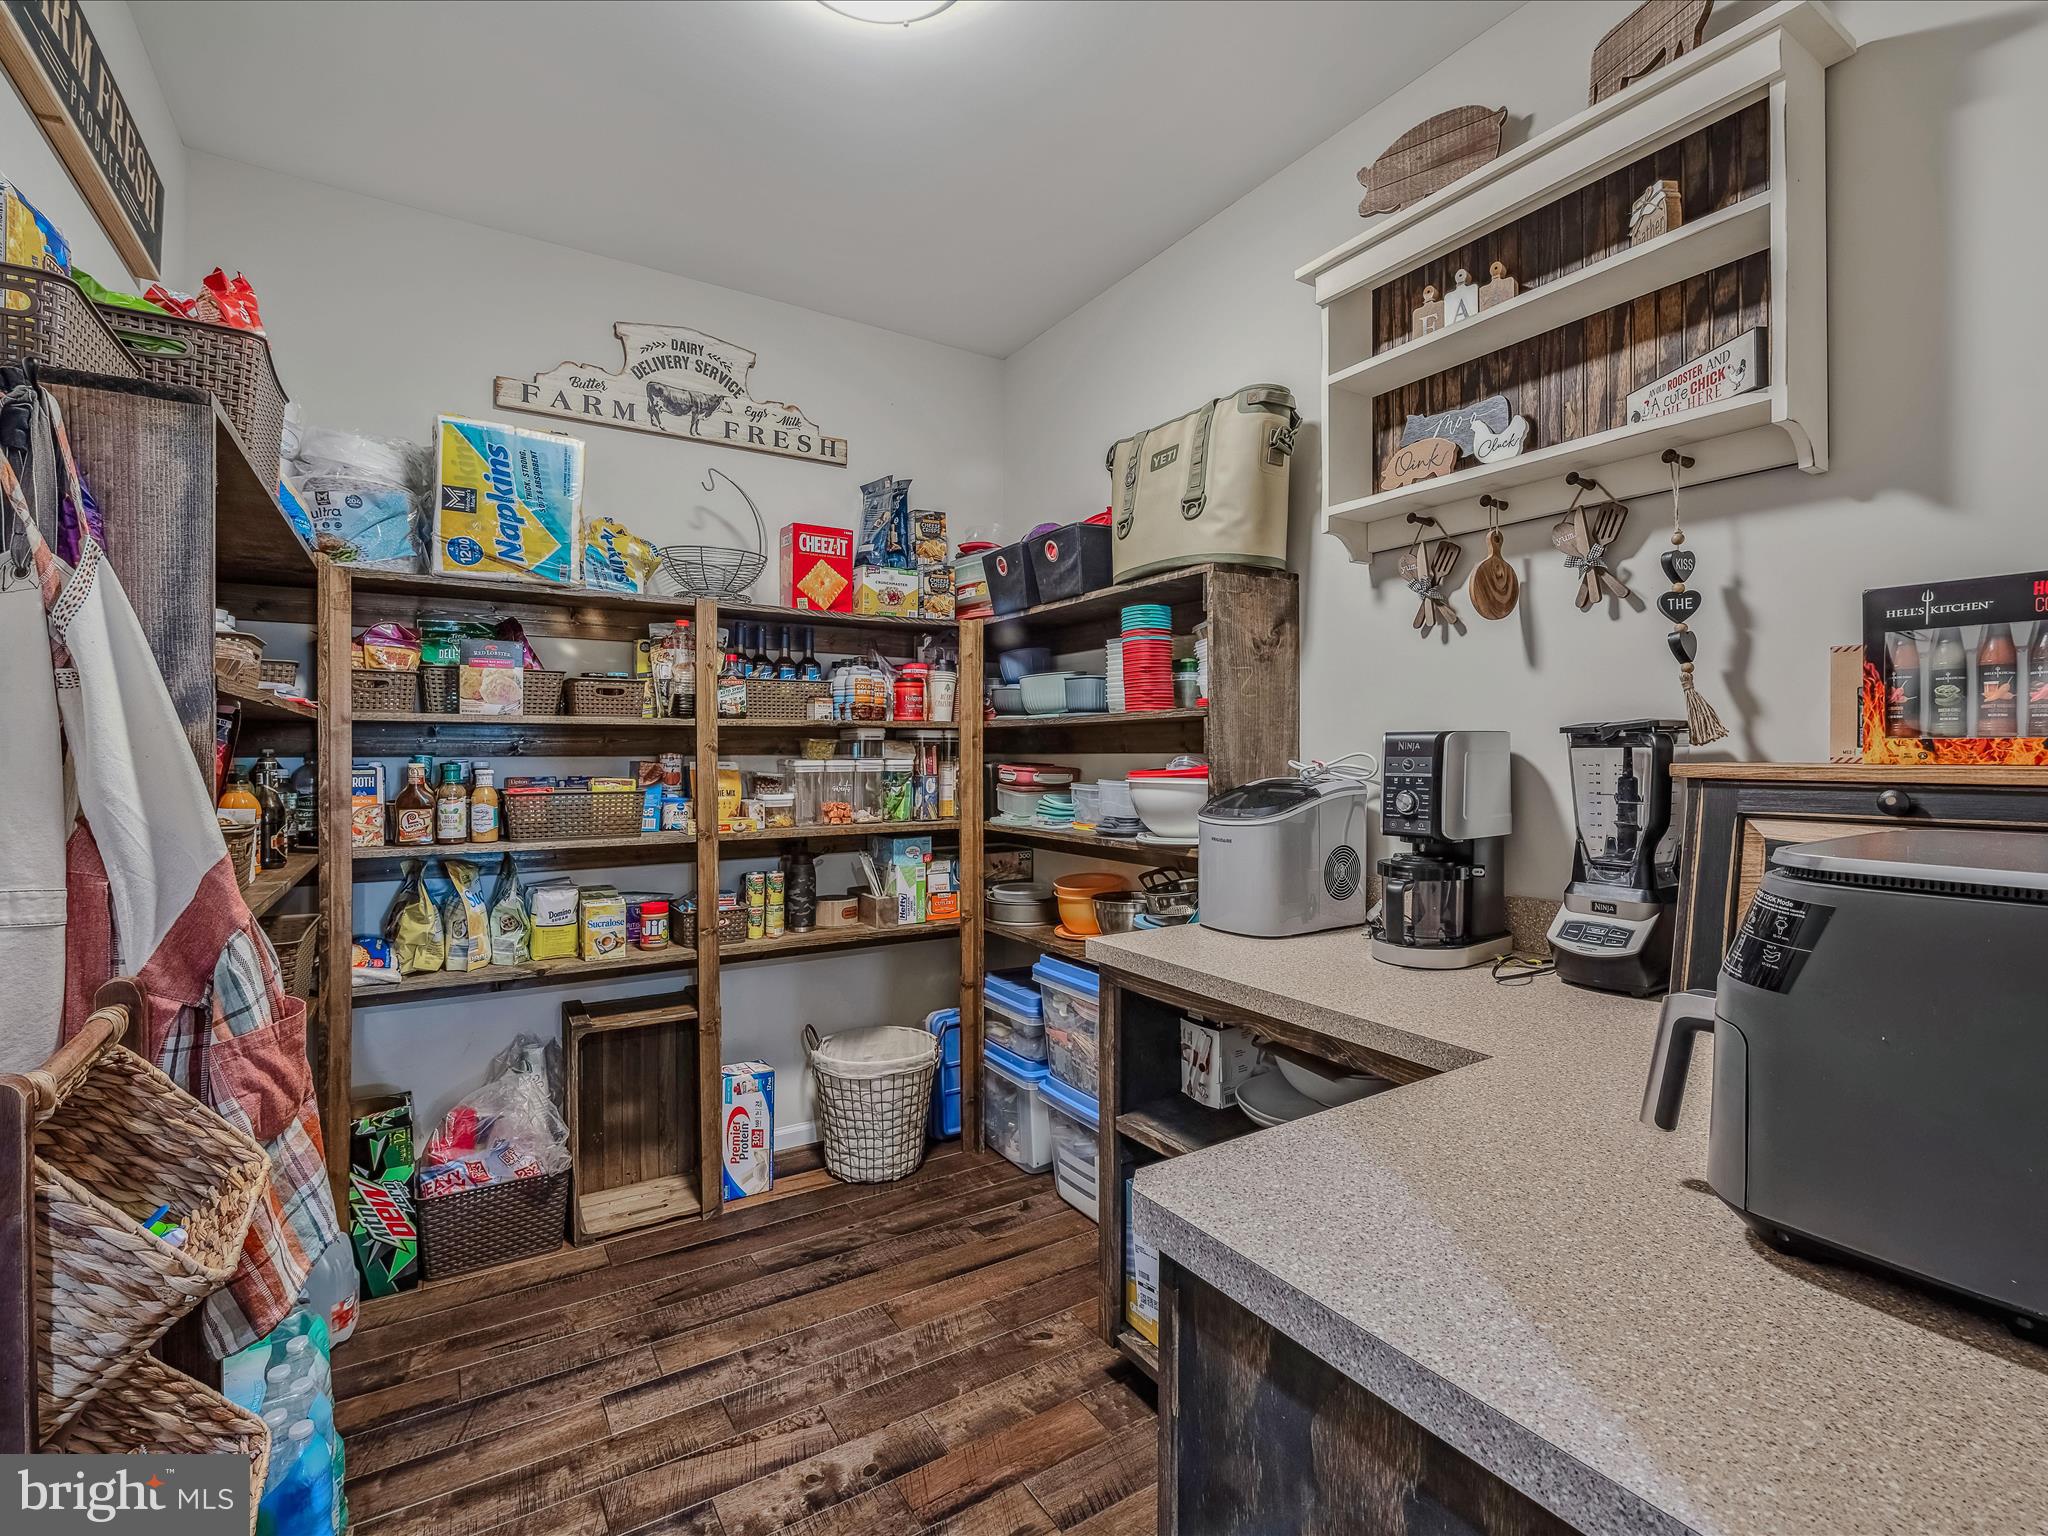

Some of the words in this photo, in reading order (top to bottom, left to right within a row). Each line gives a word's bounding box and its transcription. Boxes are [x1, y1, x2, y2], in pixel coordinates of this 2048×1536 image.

[69, 79, 121, 189] PRODUCE
[97, 62, 157, 234] FRESH
[671, 338, 704, 357] DAIRY
[630, 355, 689, 382] DELIVERY
[695, 359, 745, 399] SERVICE
[1667, 363, 1703, 391] ROOSTER
[1705, 349, 1731, 372] AND
[1690, 366, 1726, 395] CHICK
[569, 376, 608, 393] Butter
[1687, 383, 1722, 409] HERE
[520, 383, 636, 422] FARM
[723, 420, 837, 458] FRESH
[744, 405, 769, 424] Eggs
[777, 414, 803, 430] Milk
[1152, 448, 1177, 468] YETI
[1477, 435, 1523, 458] Cluck
[519, 449, 530, 478] STRONG,
[530, 450, 543, 489] ABSORBENT
[1394, 442, 1447, 478] Oink
[523, 479, 533, 501] THICK,
[311, 507, 342, 519] ultra
[484, 443, 525, 563] Napkins
[458, 538, 472, 564] 1200
[1675, 558, 1694, 571] KISS
[1667, 597, 1693, 610] THE
[1886, 606, 1925, 619] HELL'S
[1398, 741, 1421, 752] NINJA
[352, 776, 375, 788] ROTH
[548, 908, 572, 920] Domino
[899, 895, 907, 919] Hefty
[1594, 903, 1615, 913] NINJA
[551, 915, 569, 923] SUGAR
[587, 919, 625, 929] Sucralose
[641, 918, 667, 936] Jif
[730, 1120, 741, 1165] Premier
[739, 1122, 749, 1160] Protein
